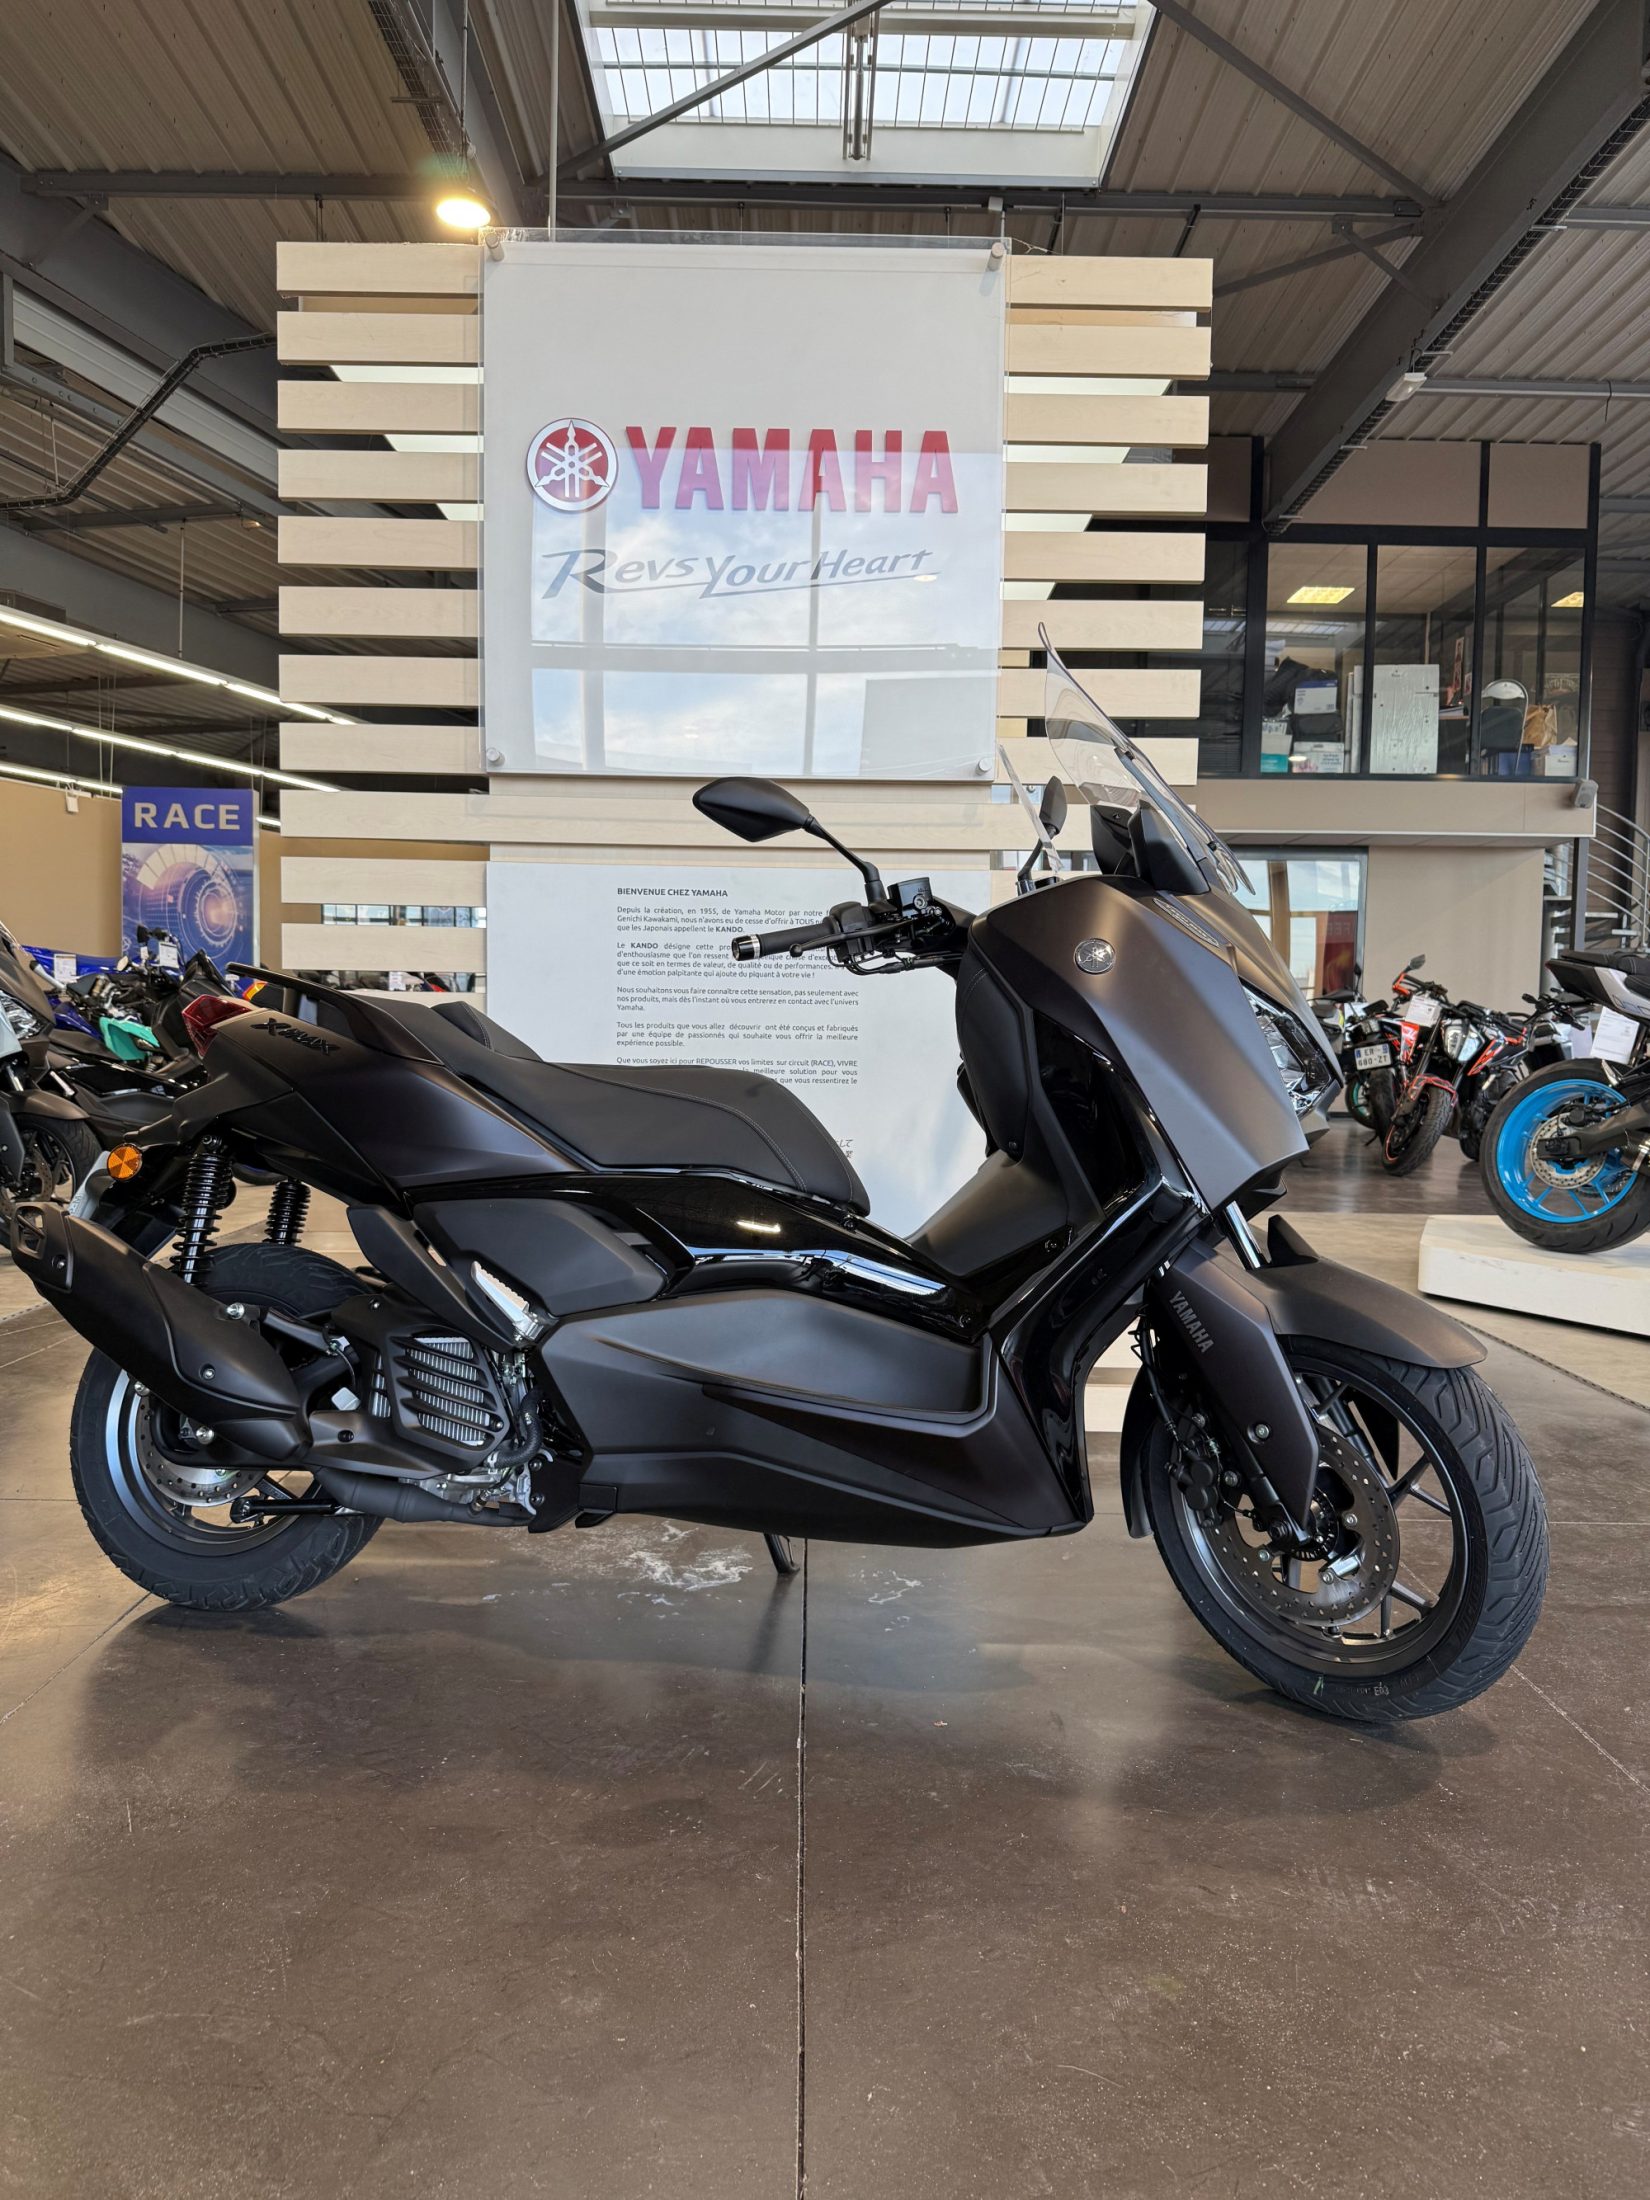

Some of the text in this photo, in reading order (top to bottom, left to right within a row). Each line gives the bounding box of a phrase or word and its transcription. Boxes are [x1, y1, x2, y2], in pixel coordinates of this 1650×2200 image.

[626, 426, 958, 514] YAMAHA
[542, 548, 933, 599] Revs Your Heart
[134, 803, 241, 830] RACE
[691, 888, 728, 896] YAMAHA
[617, 906, 640, 915] Depuis
[789, 909, 800, 917] par
[617, 925, 630, 933] que
[643, 925, 672, 933] Japonais
[674, 925, 706, 934] appellent
[664, 942, 690, 951] désigne
[696, 942, 714, 950] cette
[673, 952, 686, 960] que
[667, 960, 690, 968] termes
[738, 961, 761, 970] qualité
[668, 969, 702, 978] palpitante
[704, 970, 714, 978] qui
[716, 970, 737, 979] ajoute
[749, 970, 774, 979] piquant
[647, 1022, 674, 1031] produits
[677, 1023, 690, 1031] que
[827, 1024, 858, 1033] fabriqués
[649, 1031, 671, 1040] équipe
[688, 1031, 725, 1040] passionnés
[729, 1032, 739, 1040] qui
[617, 1039, 654, 1048] expérience
[650, 1058, 668, 1066] soyez
[1169, 1290, 1214, 1353] YAMAHA
